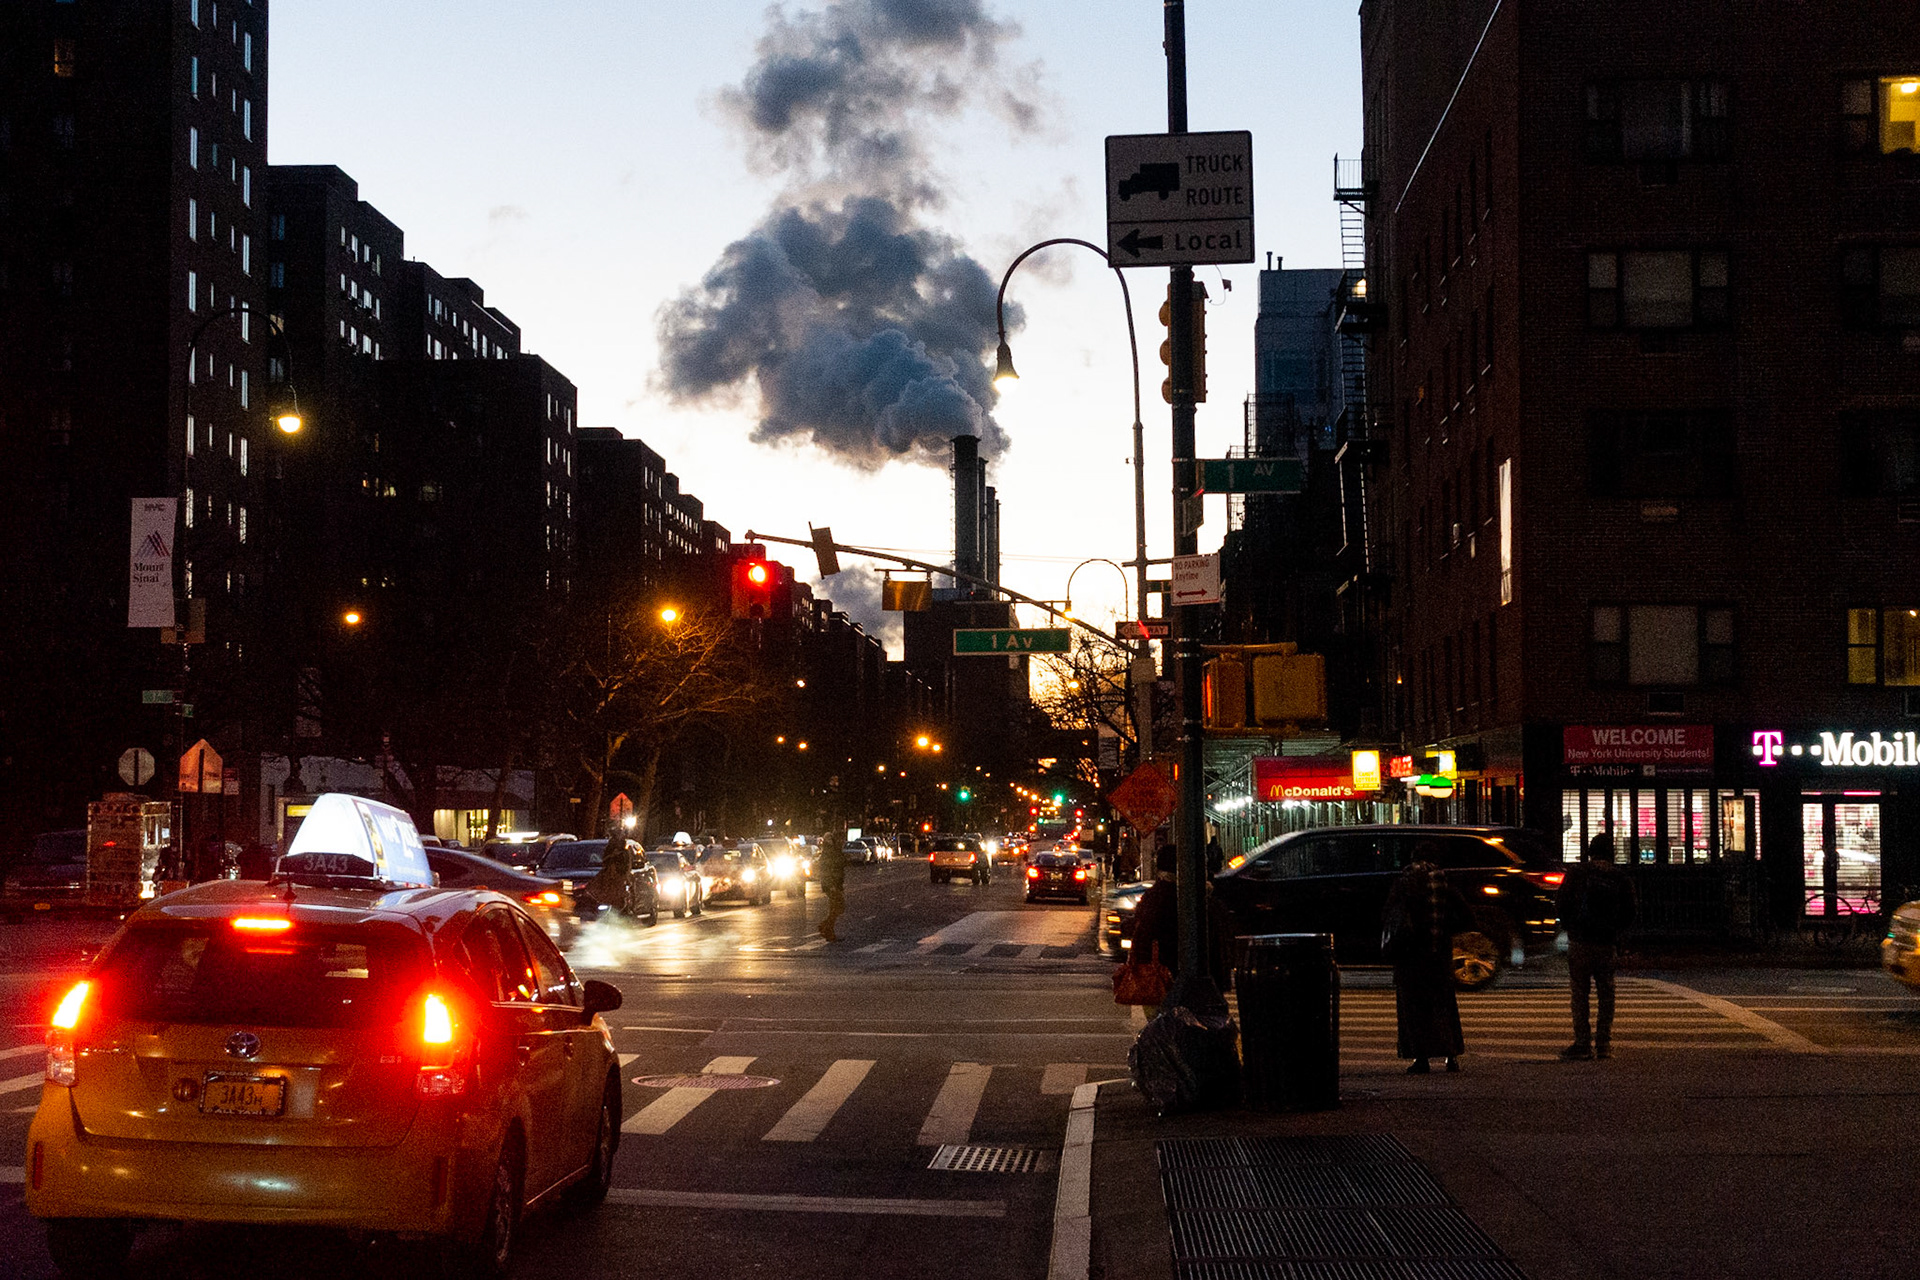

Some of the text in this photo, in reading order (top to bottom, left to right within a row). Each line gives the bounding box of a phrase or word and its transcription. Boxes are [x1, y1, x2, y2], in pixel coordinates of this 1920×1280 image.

[1185, 154, 1243, 174] TRUCK
[1186, 186, 1244, 206] ROUTE
[1175, 229, 1243, 251] Local
[1228, 462, 1275, 489] 1 AV
[133, 562, 164, 572] Mount
[1184, 559, 1210, 570] PARKING
[132, 572, 159, 583] Sinai
[1123, 626, 1139, 635] ONE
[991, 633, 1033, 649] 1 Av
[1591, 728, 1686, 745] WELCOME
[1567, 747, 1710, 761] New York University Students!
[1819, 730, 1920, 767] Mobil
[1270, 784, 1353, 798] McDonald's
[303, 854, 349, 873] 3A43
[220, 1085, 263, 1105] 3A43H
